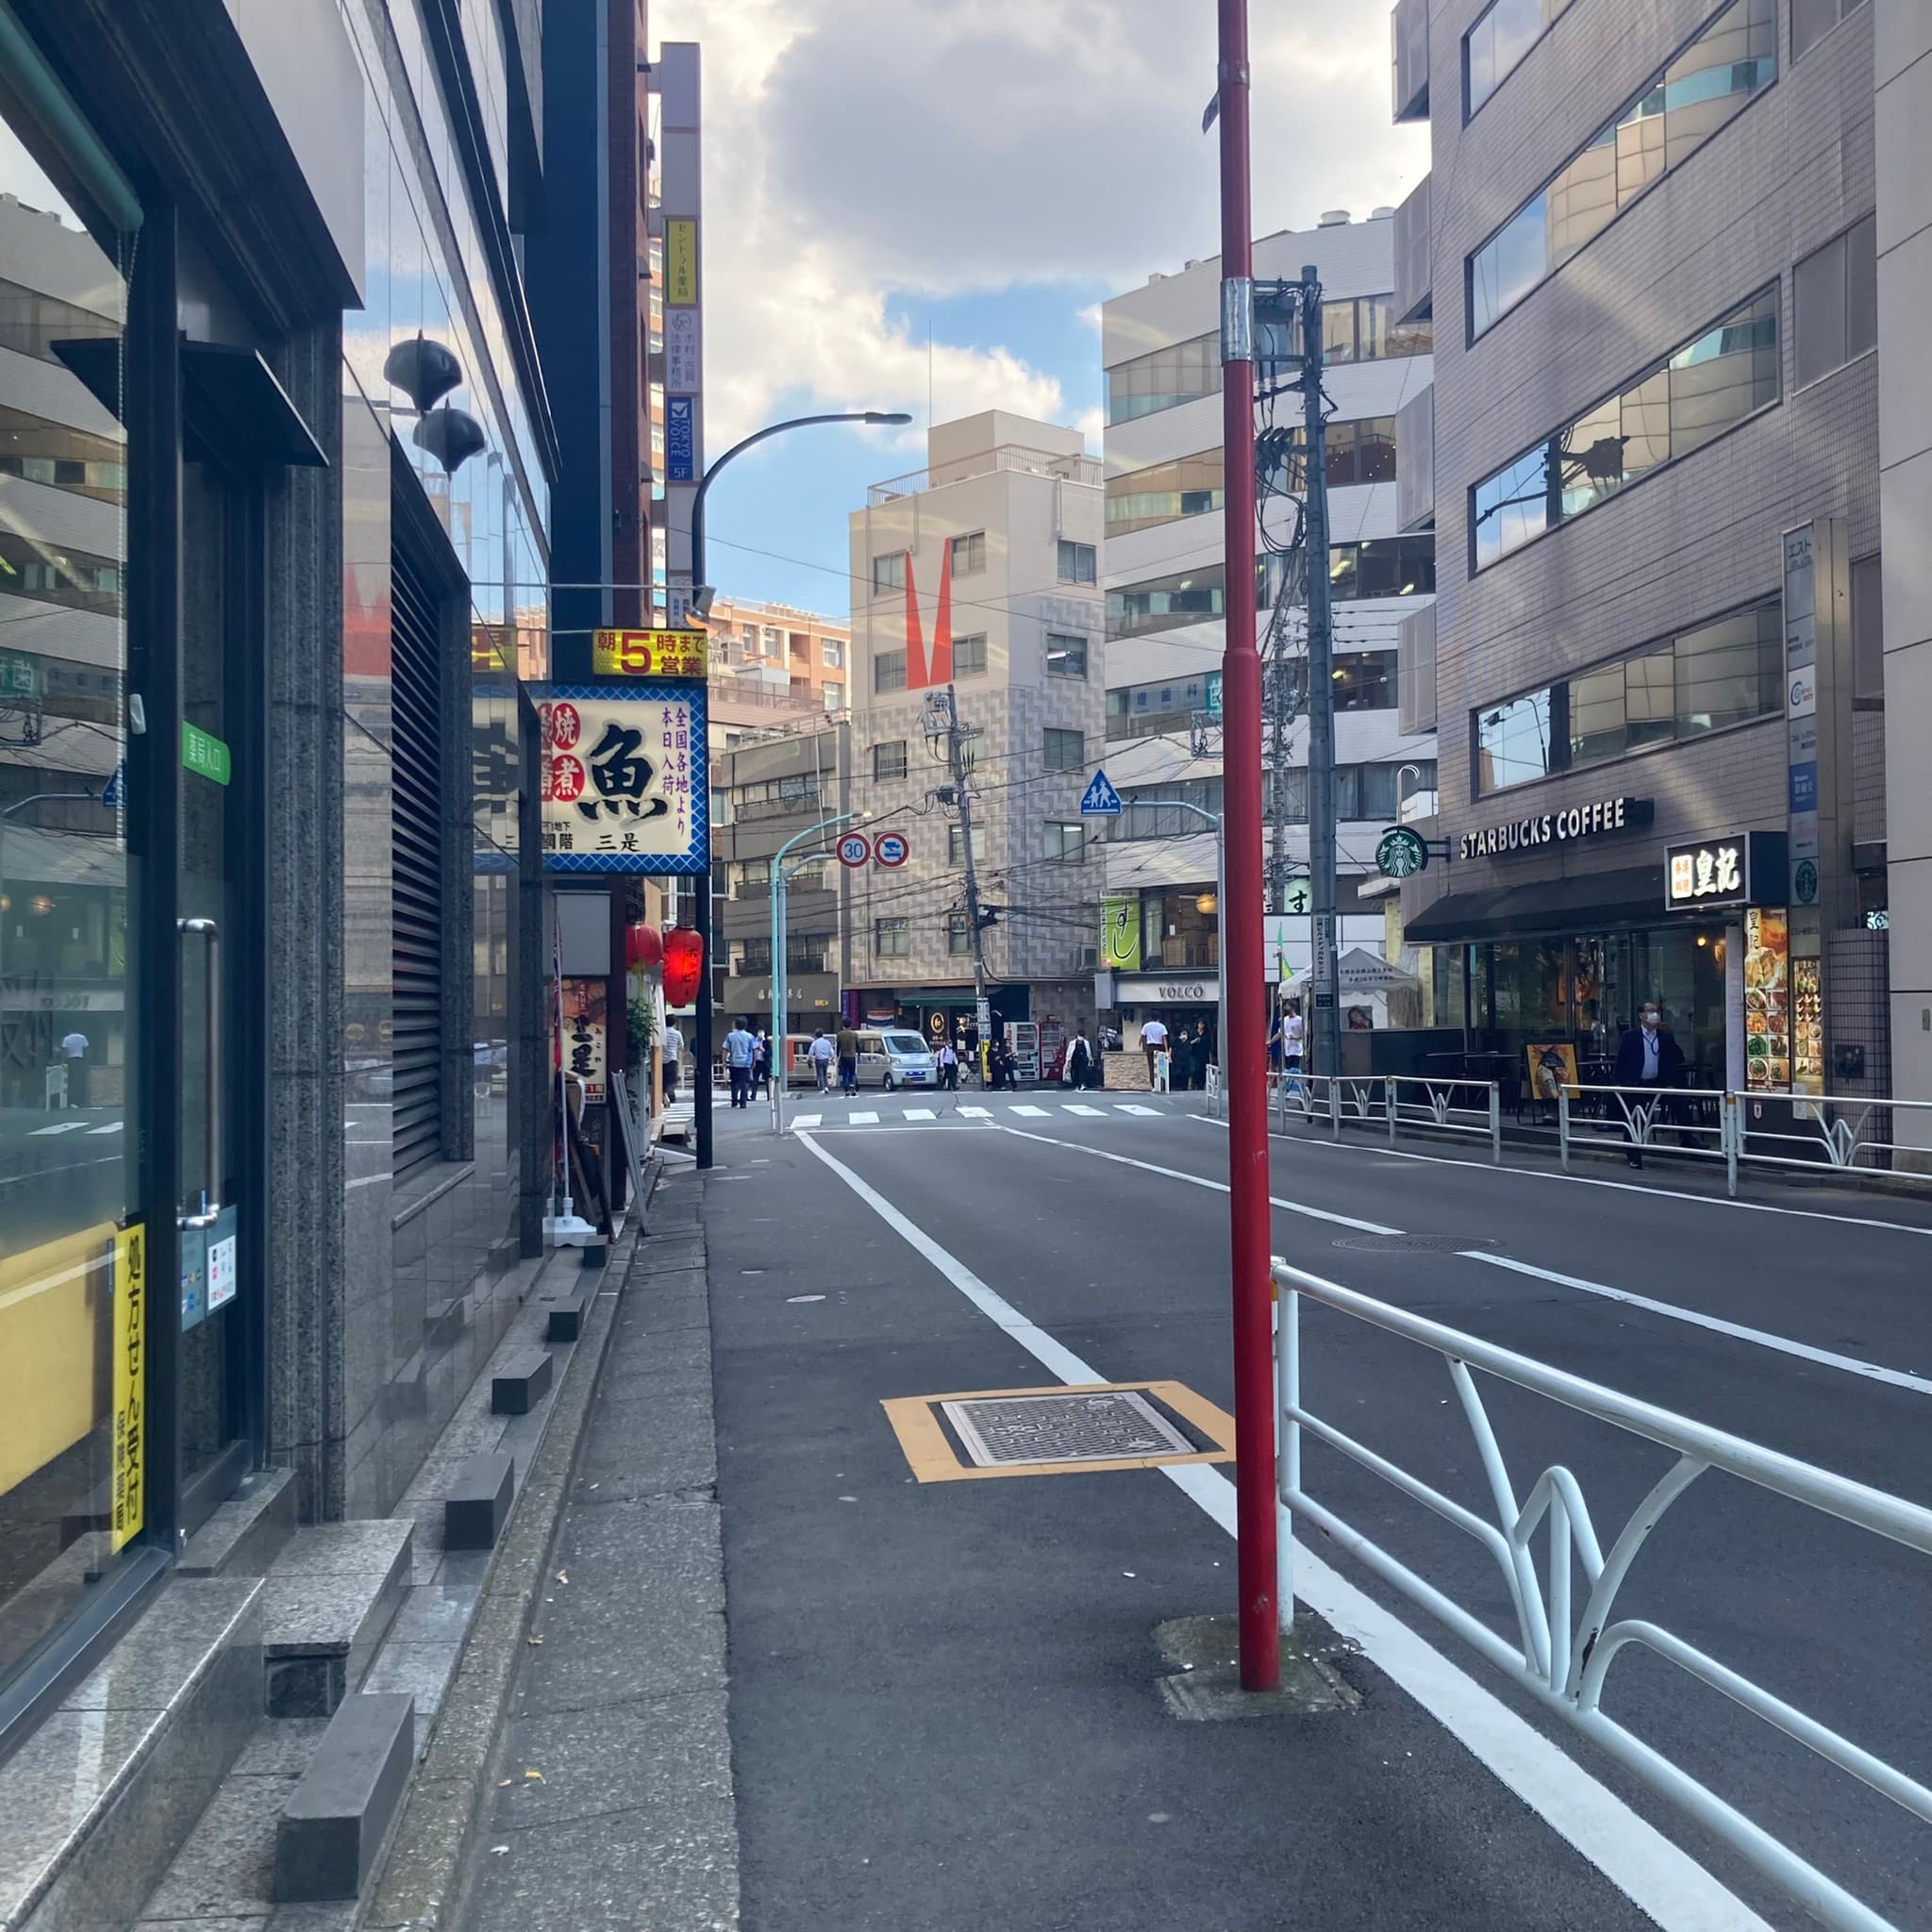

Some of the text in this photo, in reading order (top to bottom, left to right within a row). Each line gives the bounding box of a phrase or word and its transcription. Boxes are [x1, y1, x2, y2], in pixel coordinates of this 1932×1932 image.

[670, 419, 680, 458] VOICE
[680, 419, 691, 458] TOKYO
[674, 467, 688, 478] 5F
[597, 632, 704, 675] 朝5時まで
[660, 656, 703, 675] 営業
[554, 707, 577, 744] 焼
[661, 707, 675, 796] 本日入荷
[554, 758, 580, 797] 煮
[576, 723, 669, 823] 魚
[675, 707, 689, 837] 全国各地より
[595, 833, 641, 853] 三是
[1459, 797, 1625, 860] STARBUCKS COFFEE
[843, 842, 864, 858] 30
